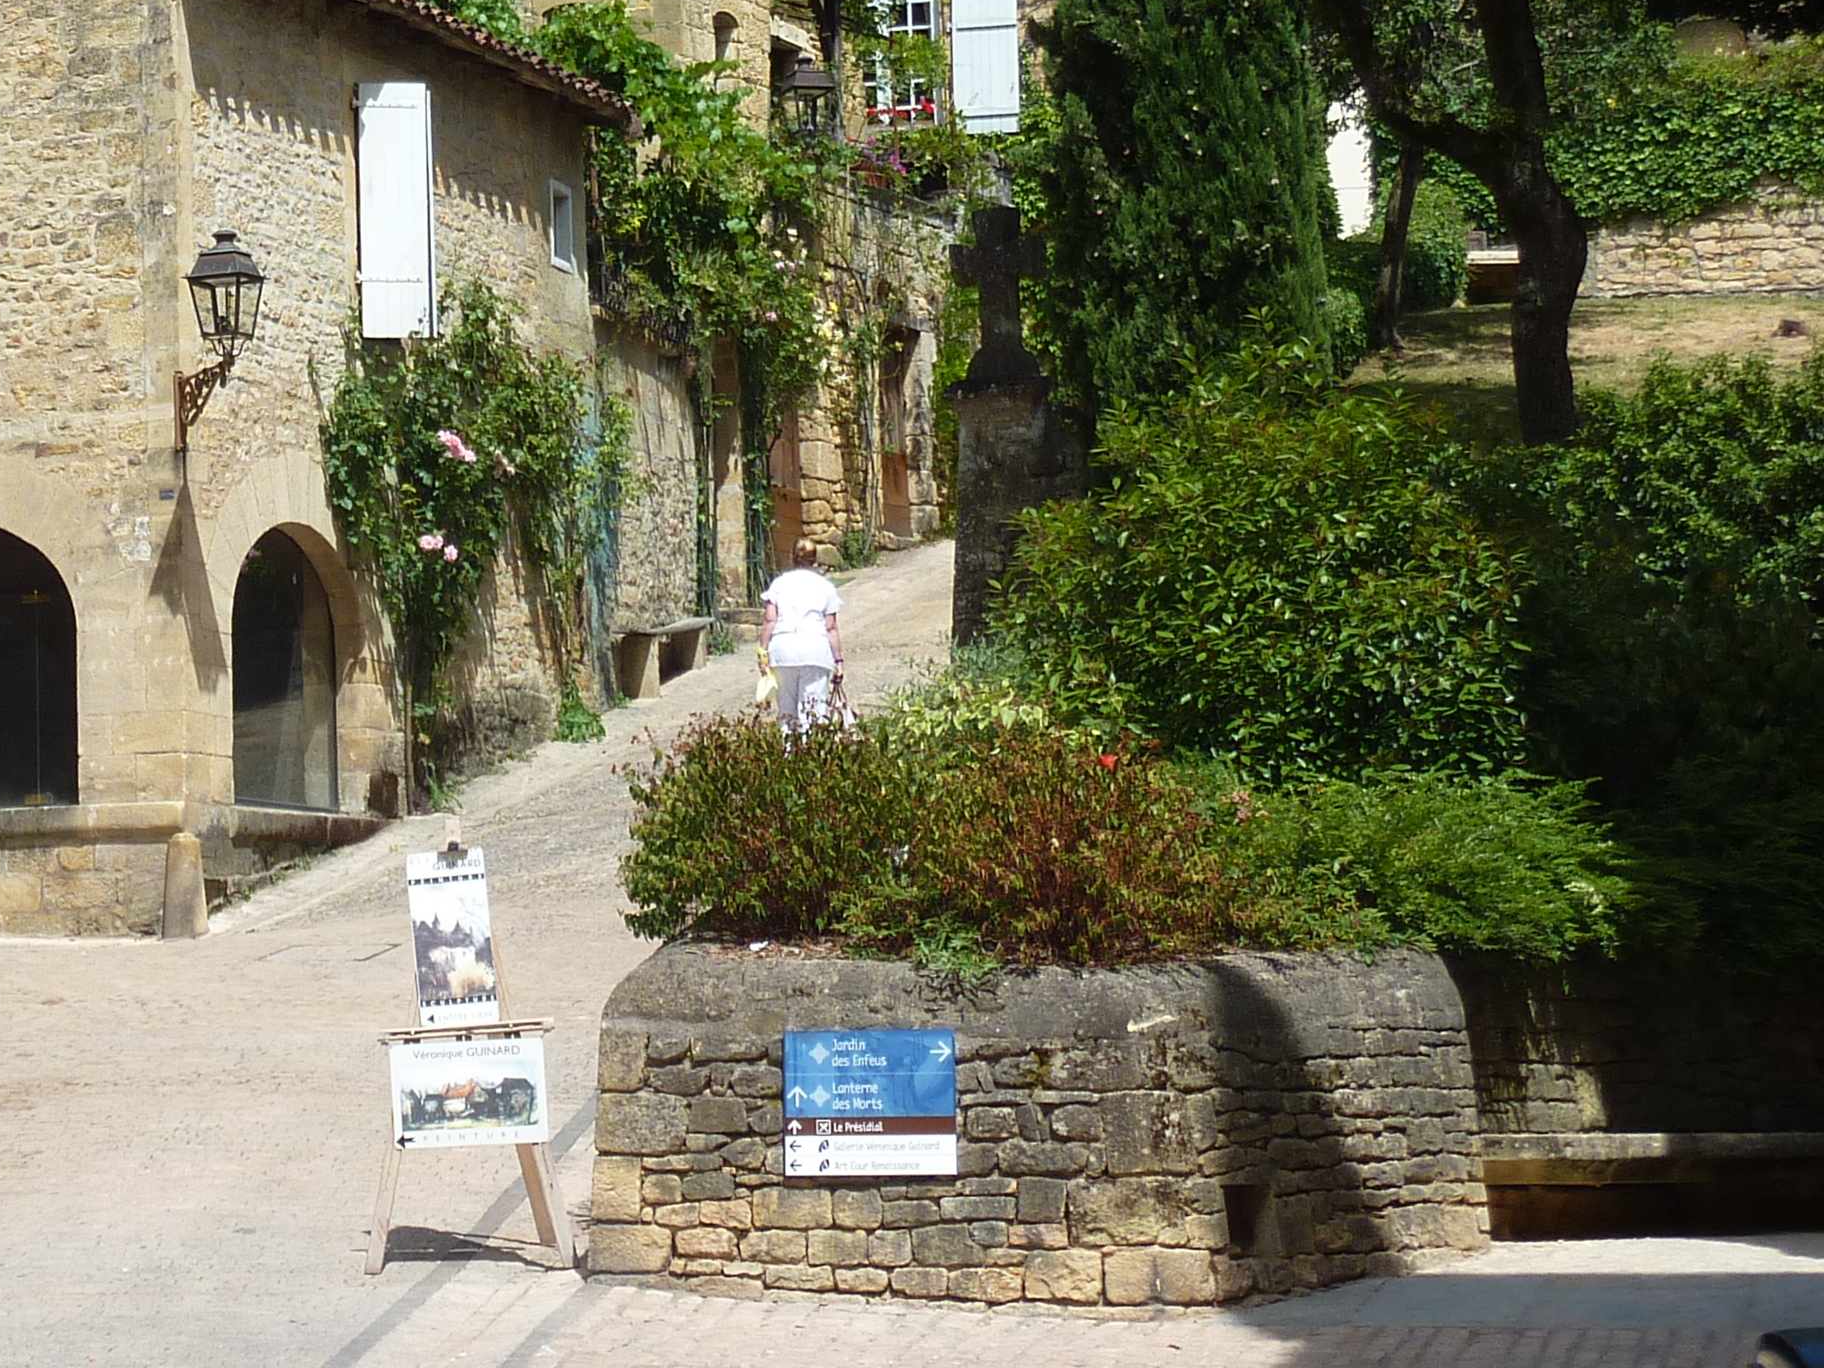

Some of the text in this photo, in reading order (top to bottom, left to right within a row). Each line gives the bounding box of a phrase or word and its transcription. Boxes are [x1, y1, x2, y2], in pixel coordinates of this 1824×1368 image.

[831, 1039, 866, 1052] Jardin
[412, 1045, 521, 1061] Véronique GUINARD
[831, 1054, 887, 1067] des Enfeus
[832, 1082, 879, 1094] Lanterne
[832, 1098, 883, 1110] des Morts
[833, 1121, 884, 1133] Le Présidial
[423, 1131, 519, 1142] PEINTURE
[833, 1141, 864, 1152] Galerie
